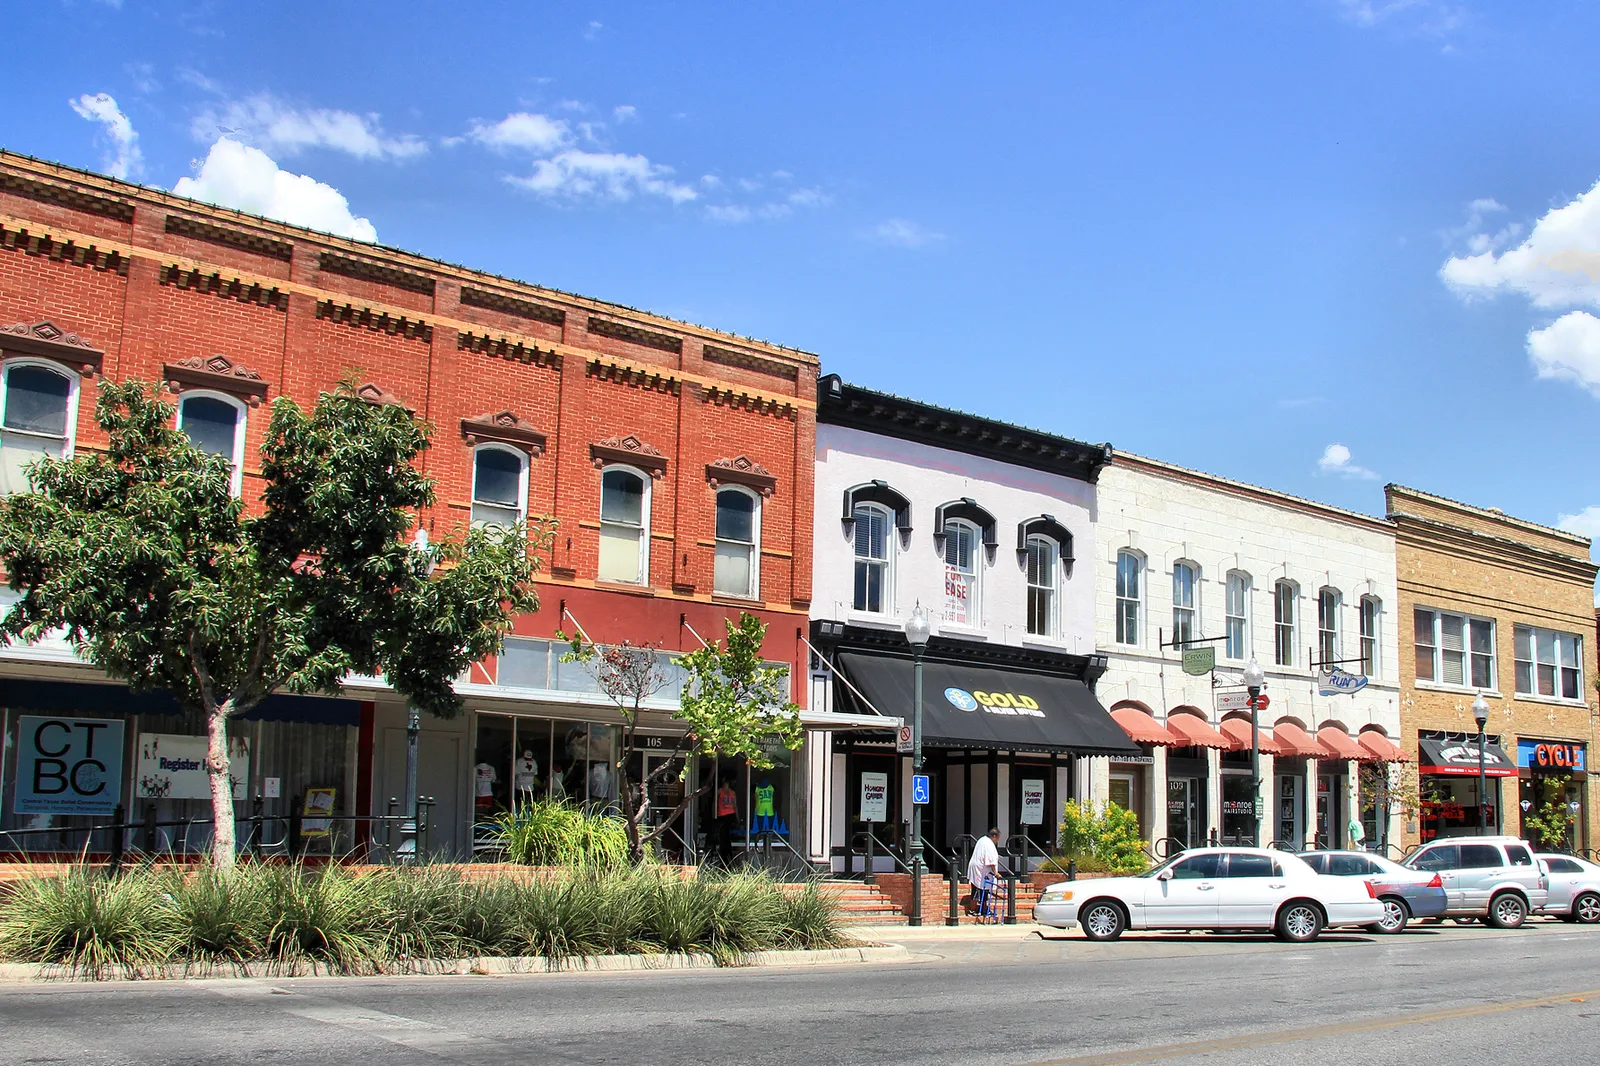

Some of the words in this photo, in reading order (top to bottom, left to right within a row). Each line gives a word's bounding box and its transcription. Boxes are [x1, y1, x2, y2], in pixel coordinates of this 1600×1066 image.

[945, 582, 967, 600] EASE
[1185, 653, 1212, 661] ERWIN
[1328, 675, 1352, 687] RUN
[973, 690, 1039, 710] GOLD
[646, 738, 662, 748] 105
[1535, 744, 1581, 767] CYCLE
[160, 757, 200, 772] Register
[1224, 801, 1253, 809] monroe
